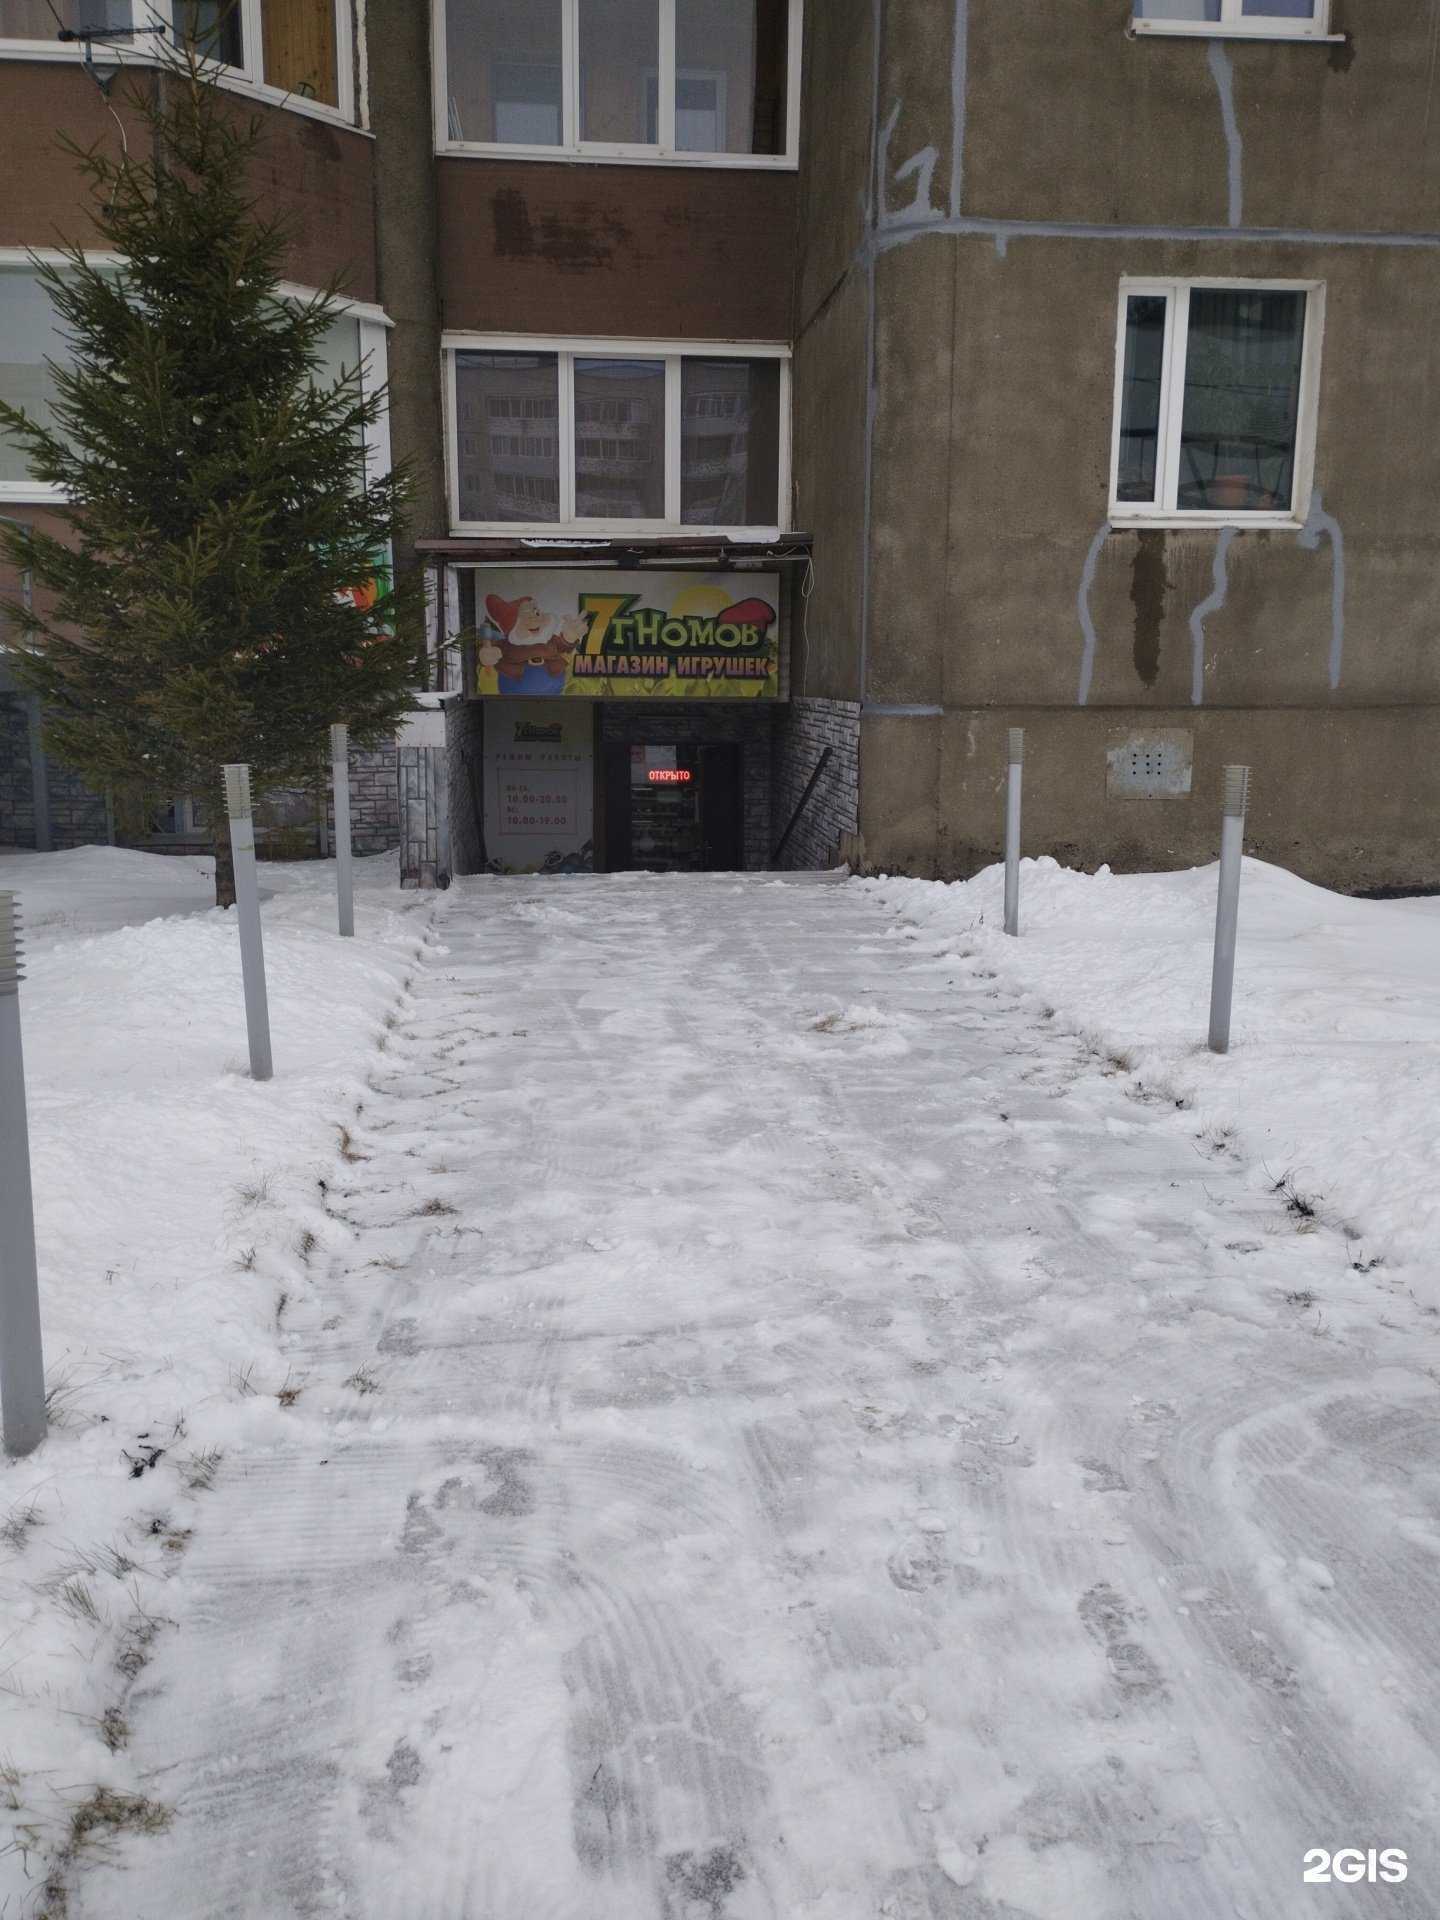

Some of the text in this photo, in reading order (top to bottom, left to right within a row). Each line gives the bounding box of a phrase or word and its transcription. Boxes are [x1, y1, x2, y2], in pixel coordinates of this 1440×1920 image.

[580, 594, 634, 655] 7
[574, 655, 772, 677] МАГАЗИН ИГРУШЕК
[649, 770, 691, 781] ОТКРЫТО
